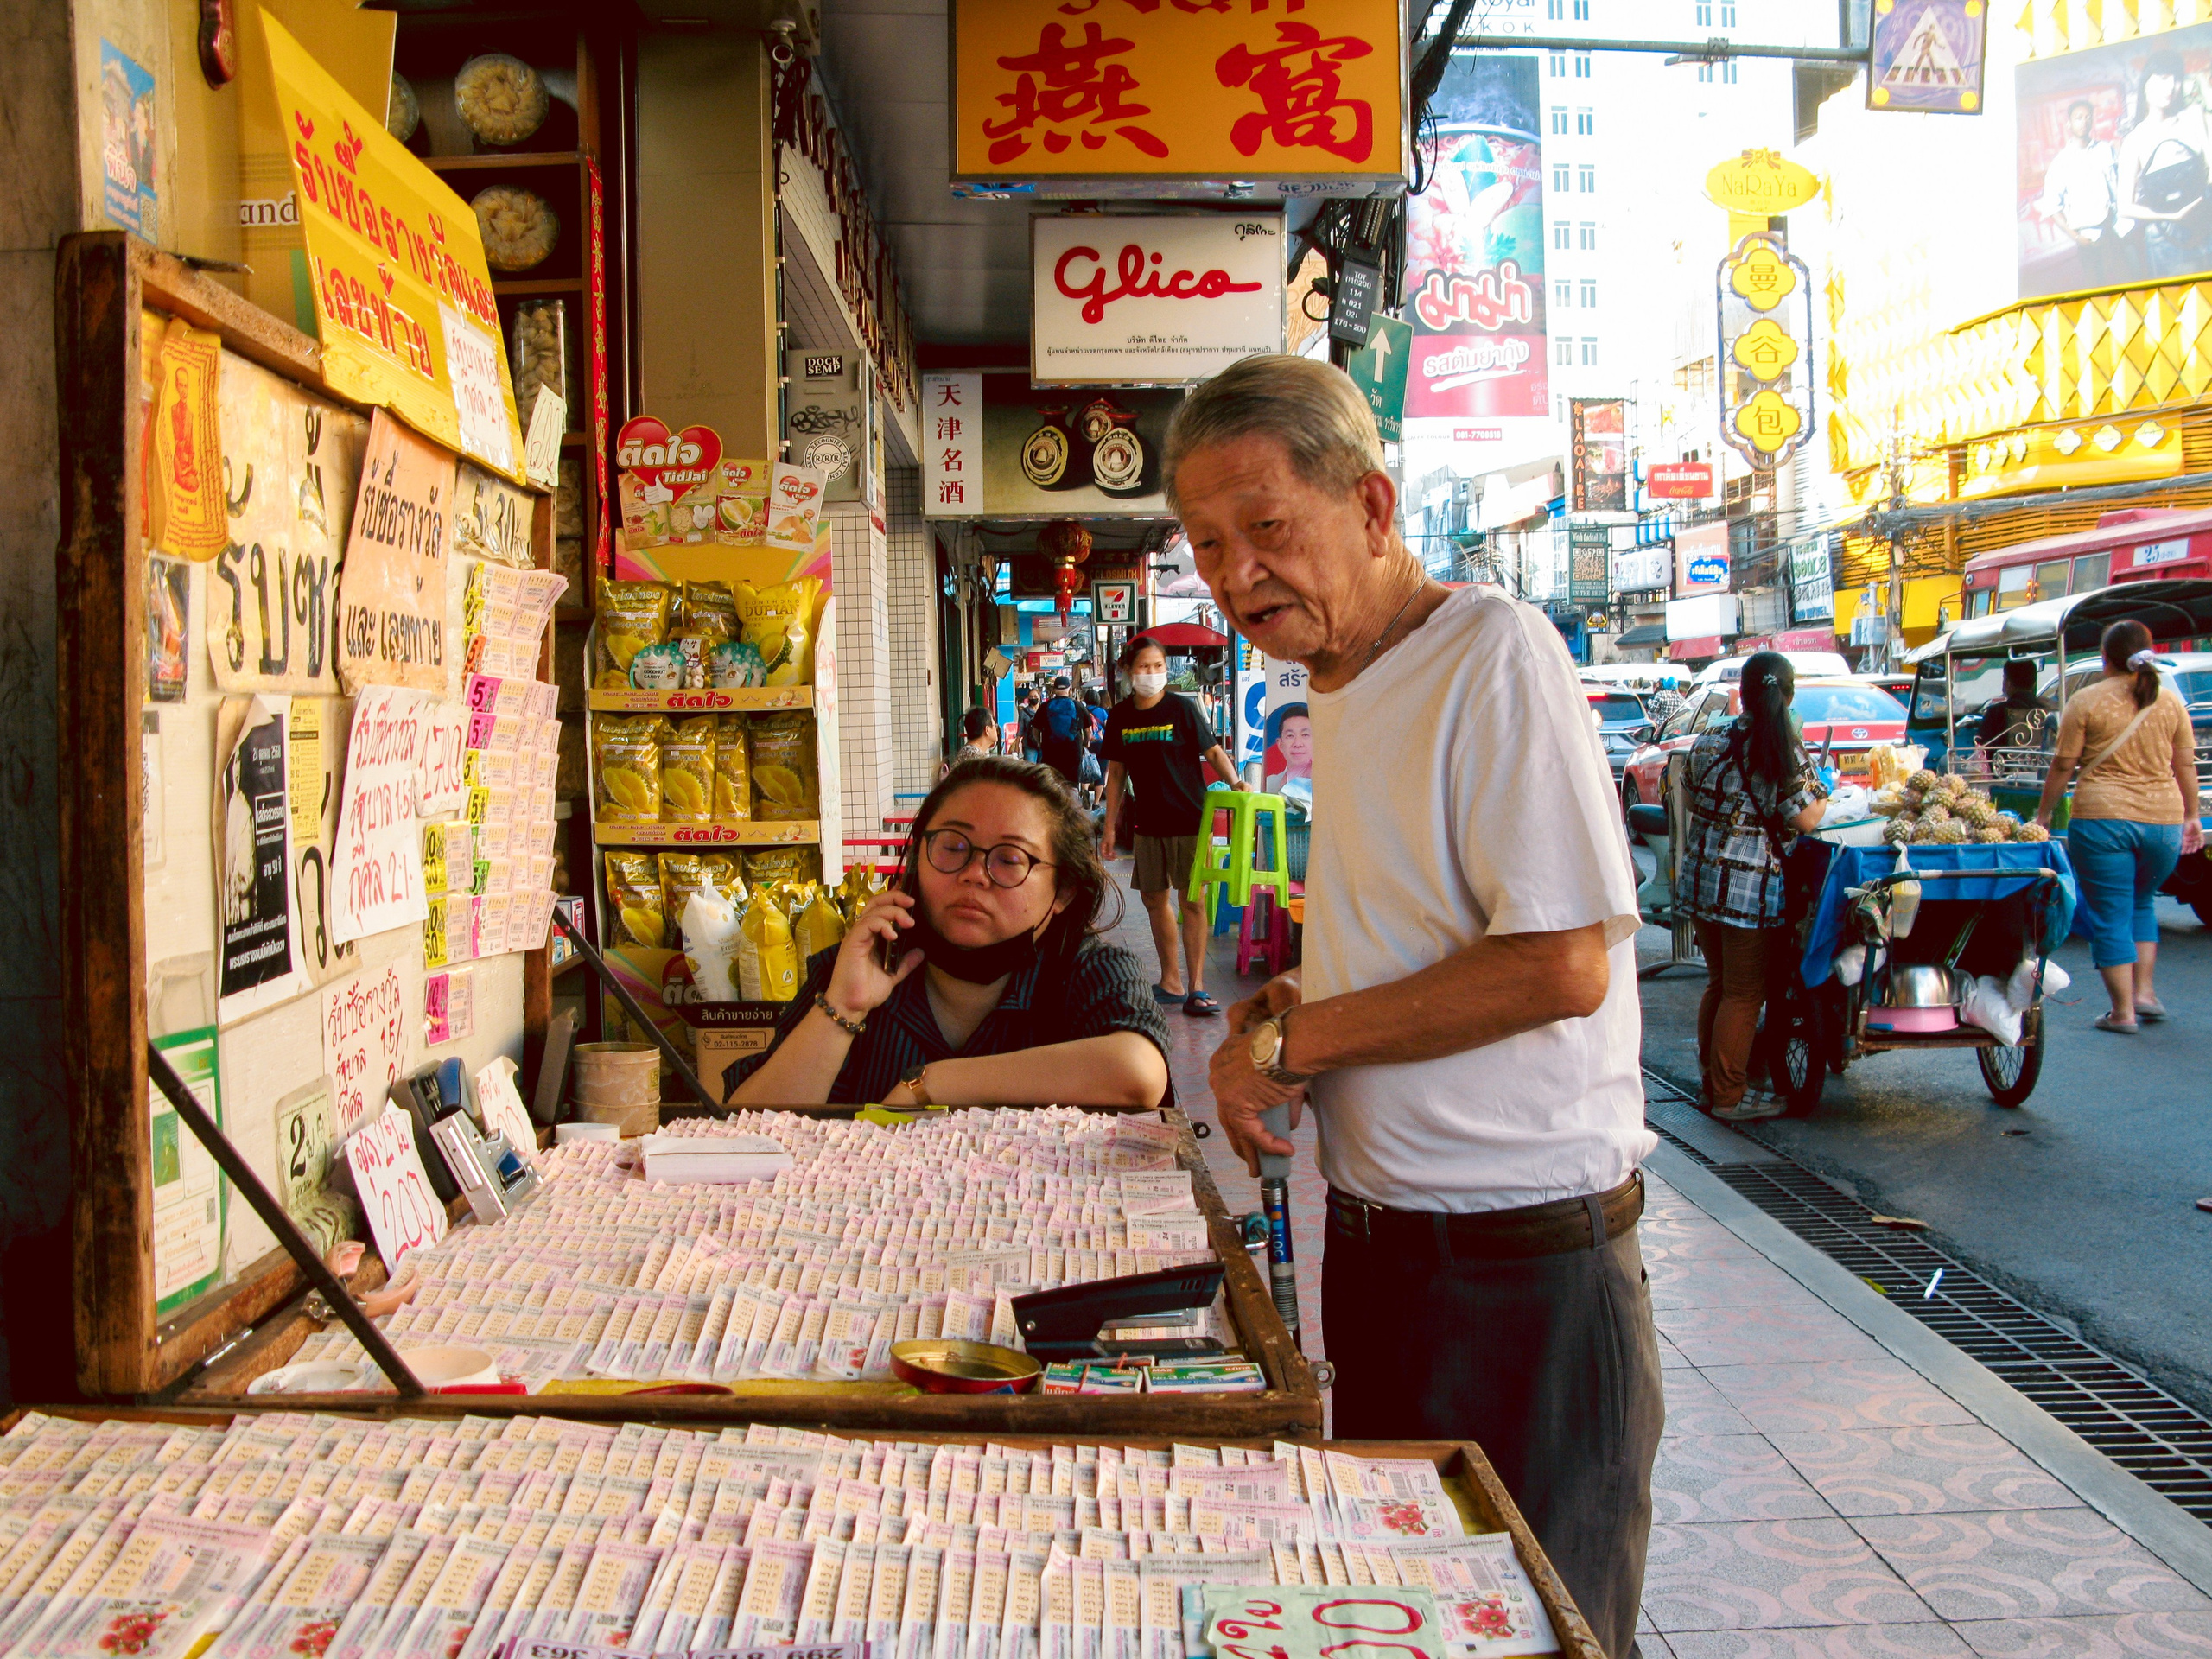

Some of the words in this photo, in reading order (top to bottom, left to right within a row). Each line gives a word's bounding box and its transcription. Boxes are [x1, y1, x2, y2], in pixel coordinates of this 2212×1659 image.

[1721, 173, 1797, 198] NaRaYa
[1054, 244, 1262, 325] Glico
[1349, 288, 1363, 298] 114
[1417, 262, 1532, 330] มาม่า
[1127, 335, 1147, 345] บริษัท
[1171, 334, 1188, 344] จำกัด
[1750, 264, 1783, 435] 曼谷包
[808, 356, 841, 366] DOCK
[808, 365, 842, 375] SEMP
[1425, 340, 1528, 375] รสต้มยำกุ้ง
[1370, 389, 1382, 408] วัด
[618, 435, 702, 467] ติดใจ
[810, 437, 843, 450] RECOGNIZE
[937, 383, 965, 505] 天津名酒
[663, 469, 709, 485] TidJai
[1573, 419, 1586, 510] LAOAIRE
[360, 450, 442, 560] รับซื้อรางวัล
[2144, 544, 2160, 563] 25
[1105, 590, 1125, 603] 7
[745, 604, 798, 618] DURIAN
[346, 604, 377, 659] และ
[471, 681, 486, 707] 5
[666, 691, 734, 709] ติดใจ
[472, 719, 481, 745] 5
[419, 724, 462, 801] 1700
[471, 793, 480, 819] 5
[672, 825, 740, 842] ติดใจ
[328, 964, 402, 1048] รับซื้อรางวัล
[702, 1007, 773, 1020] สินค้าขายง่าย
[382, 1170, 438, 1262] 200
[1016, 1571, 1027, 1621] 908138
